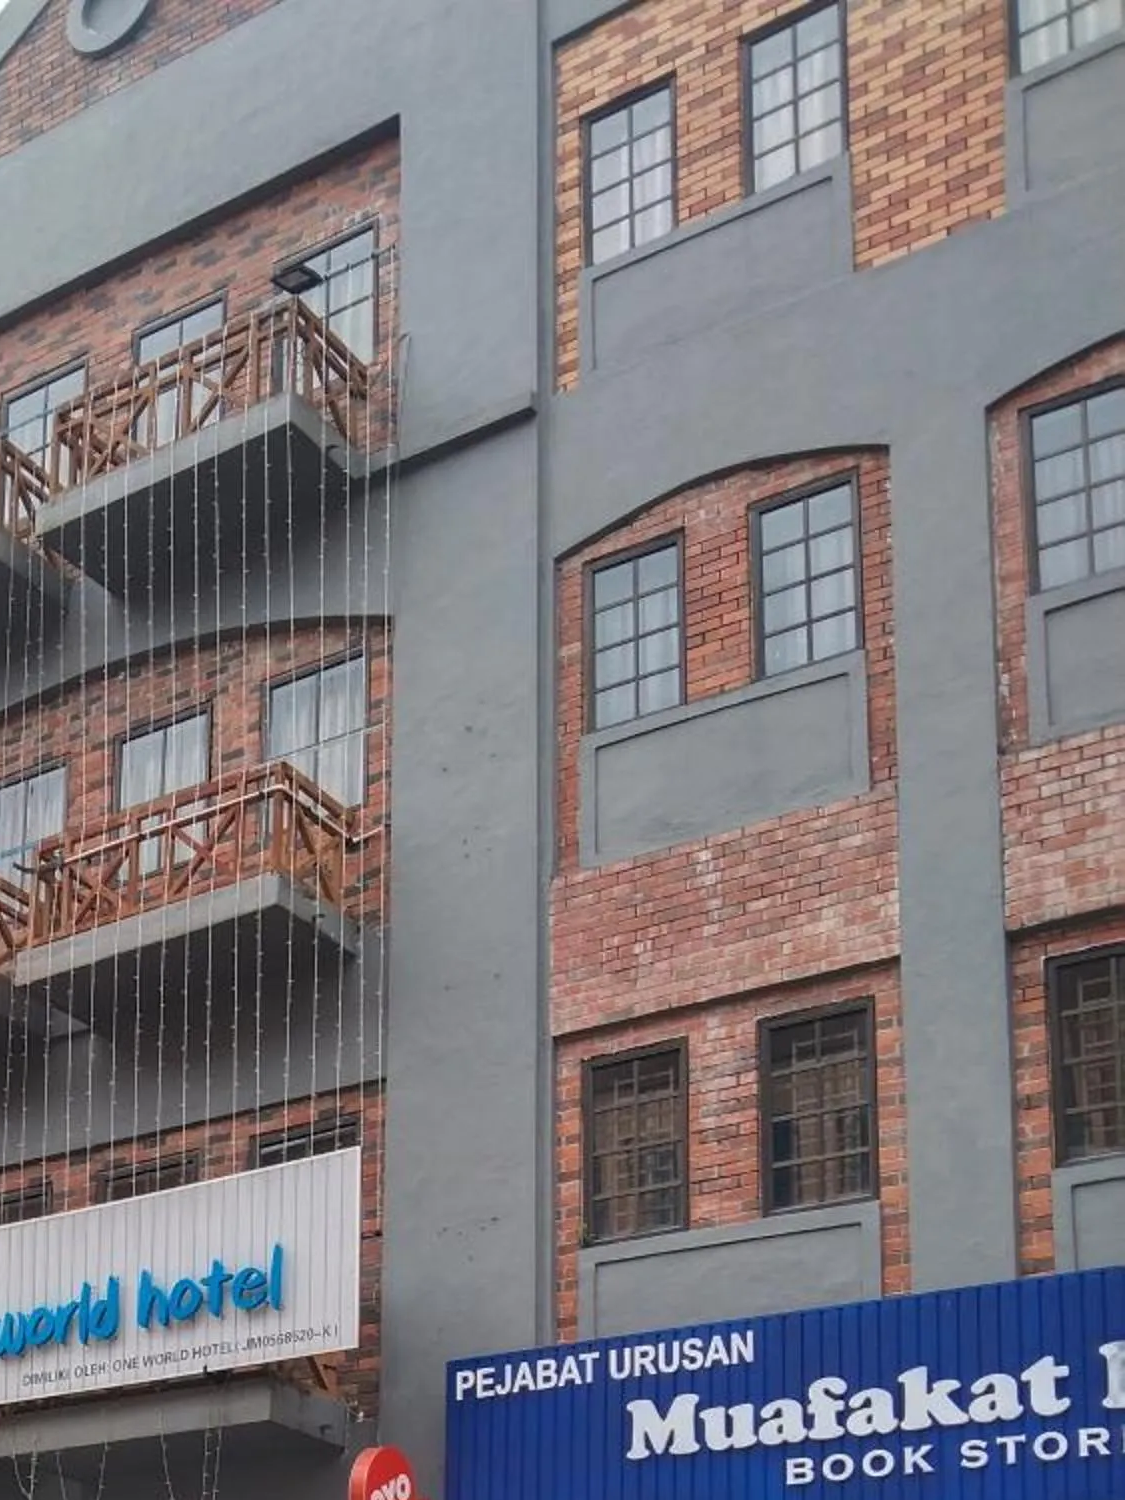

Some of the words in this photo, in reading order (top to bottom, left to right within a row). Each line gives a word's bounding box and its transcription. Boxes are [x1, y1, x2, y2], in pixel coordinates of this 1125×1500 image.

[137, 1244, 283, 1334] hotel
[112, 1356, 140, 1373] ONE
[142, 1349, 189, 1368] WORLD
[455, 1351, 600, 1401] PEJABAT
[609, 1330, 755, 1381] URUSAN
[625, 1354, 1072, 1460] Muafakat
[785, 1443, 935, 1486] BOOK
[959, 1424, 1125, 1469] STOR
